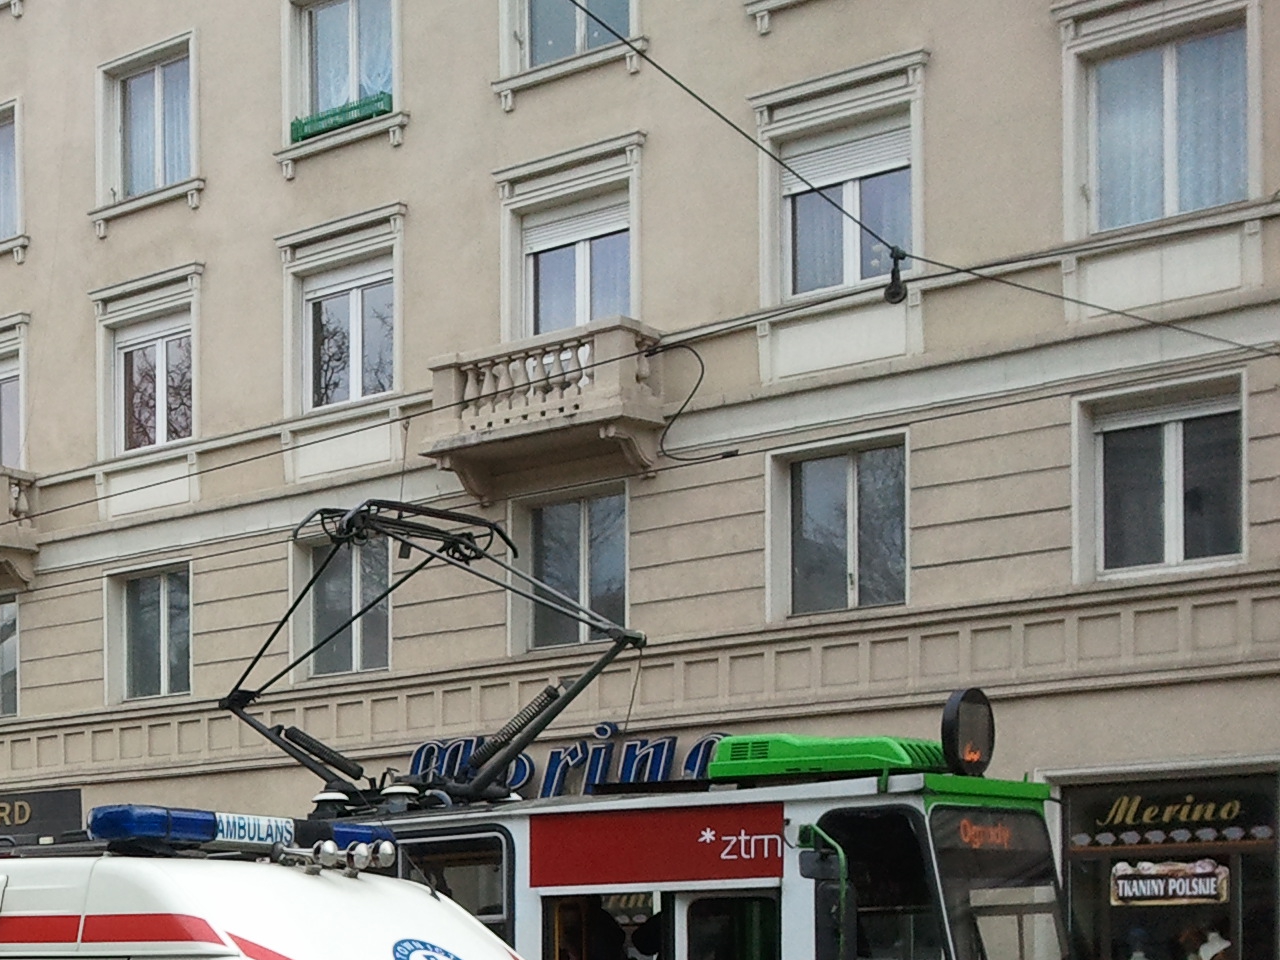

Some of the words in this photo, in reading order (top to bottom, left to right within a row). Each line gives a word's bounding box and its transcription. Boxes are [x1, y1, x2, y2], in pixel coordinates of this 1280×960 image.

[1096, 794, 1241, 826] Merino
[217, 814, 293, 846] AMBULANS
[1117, 879, 1166, 897] TKANINY
[1169, 877, 1217, 896] POLSKIE
